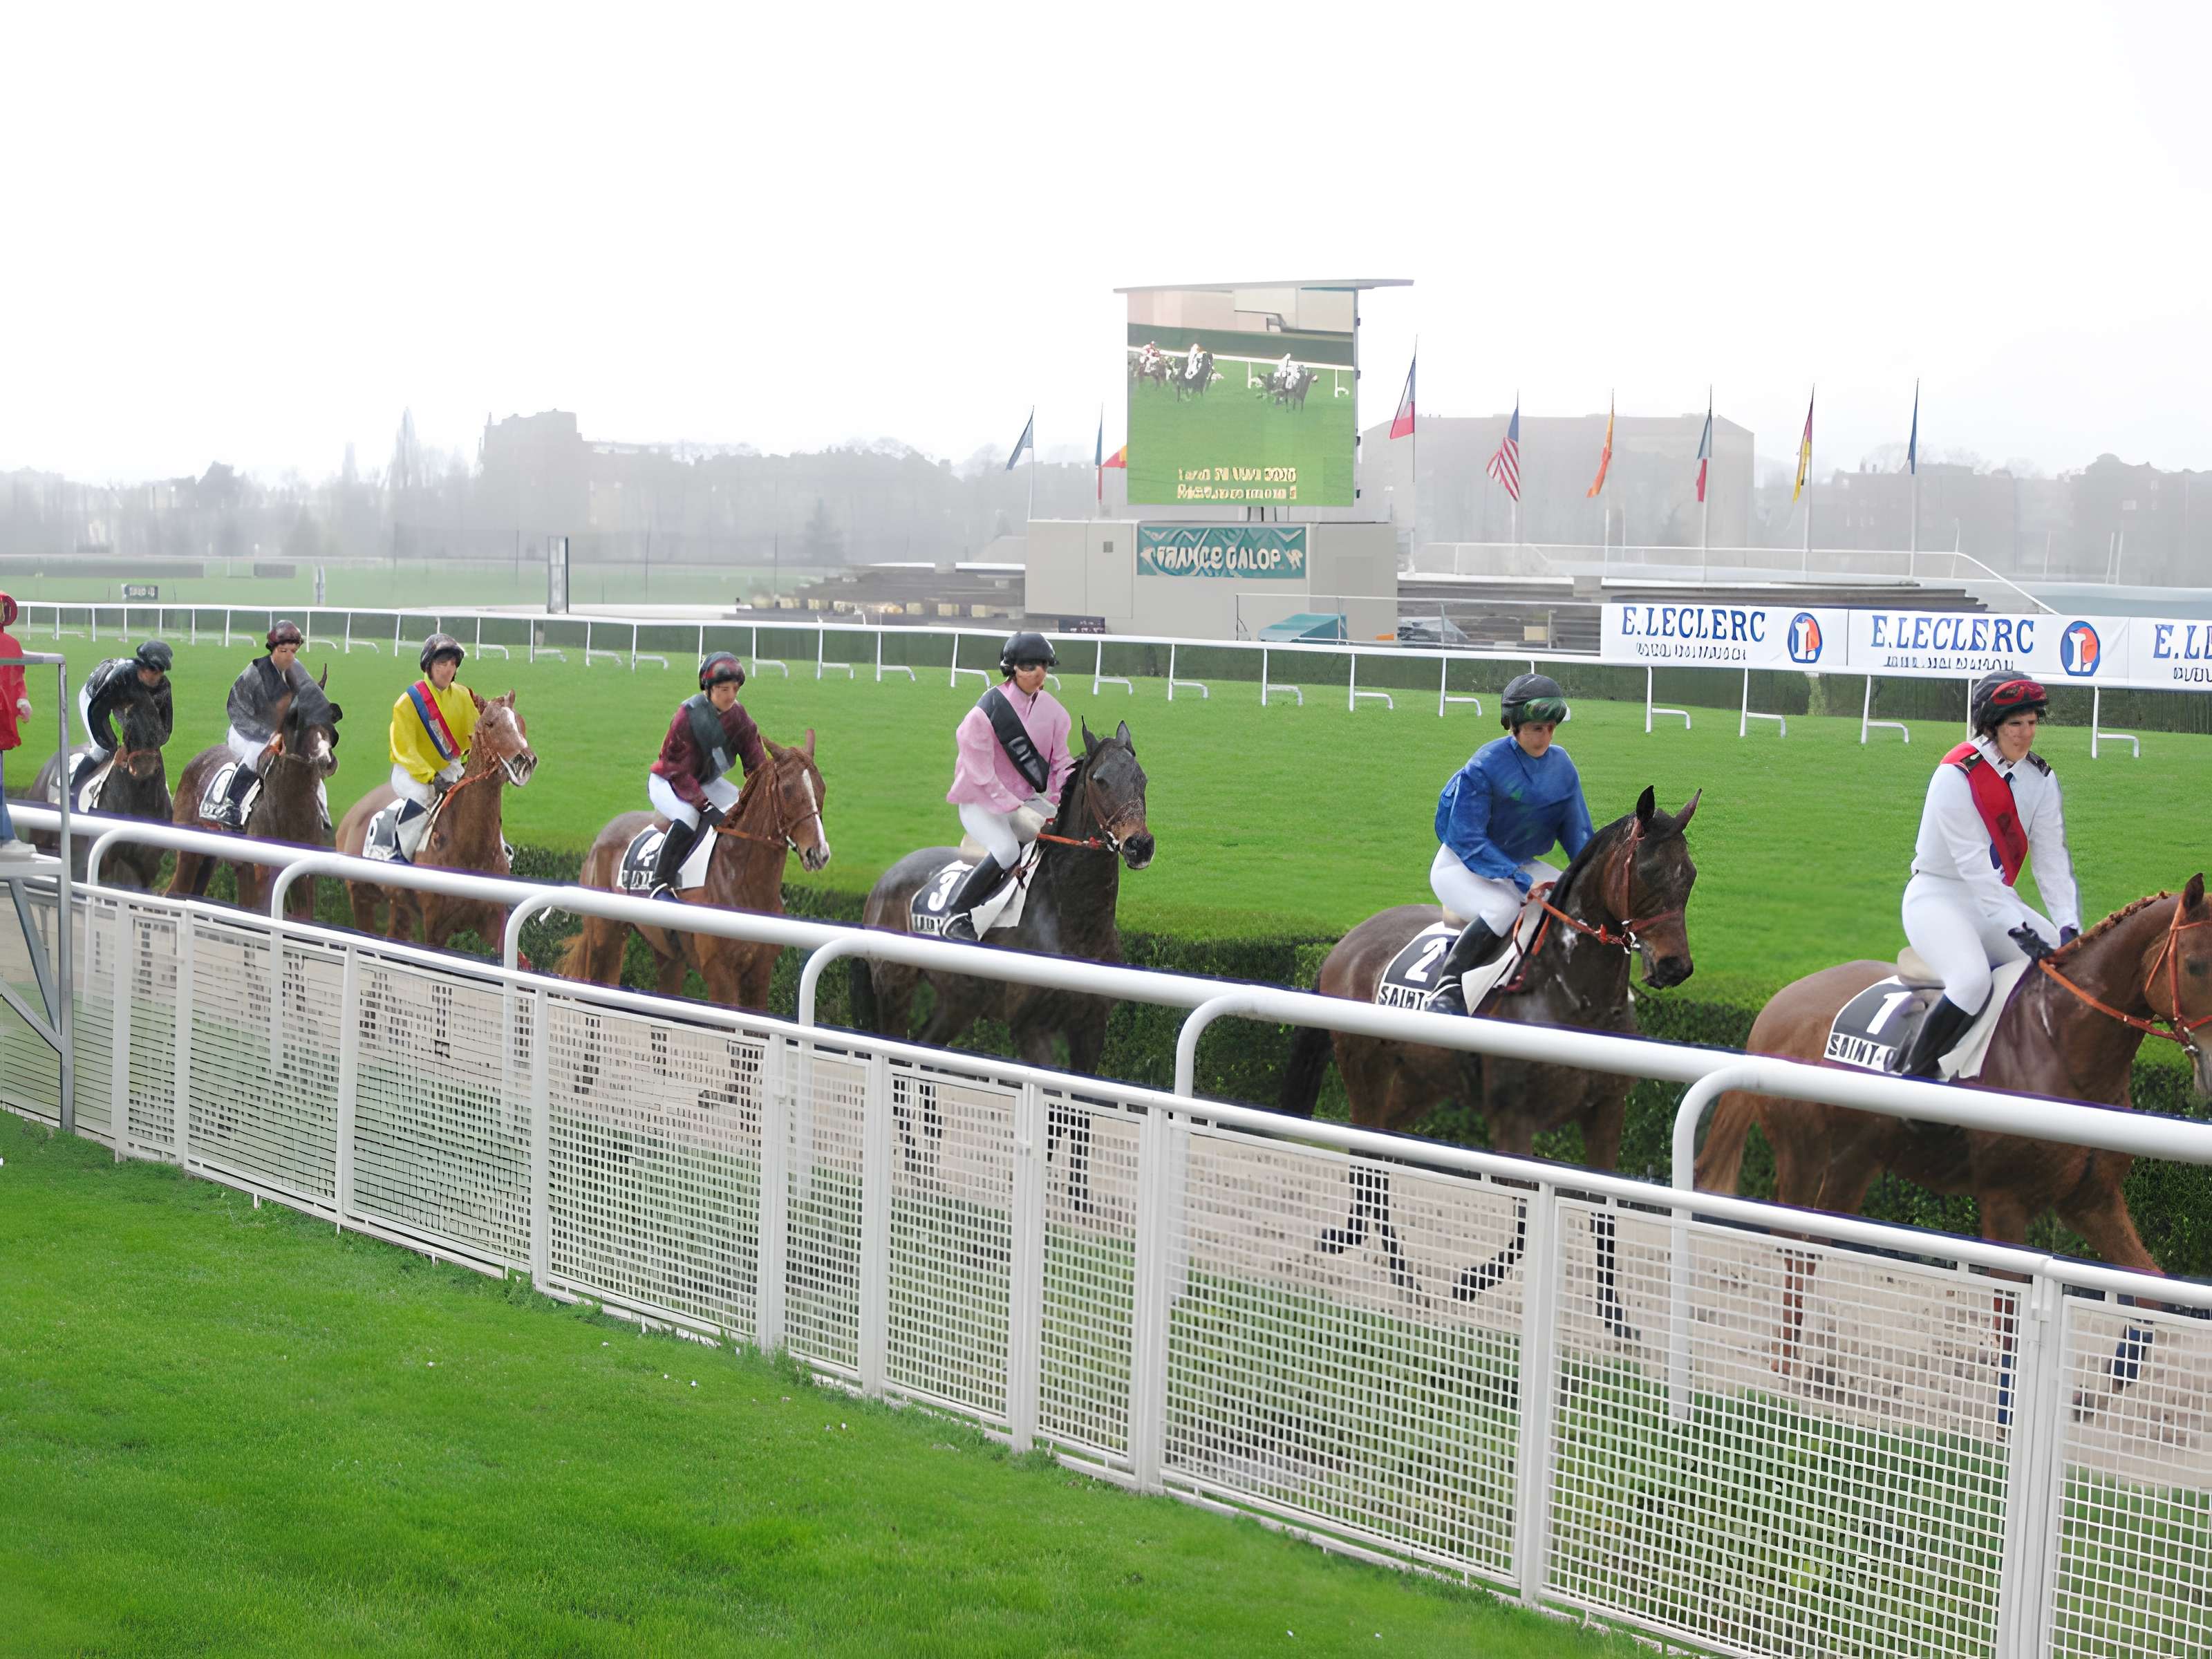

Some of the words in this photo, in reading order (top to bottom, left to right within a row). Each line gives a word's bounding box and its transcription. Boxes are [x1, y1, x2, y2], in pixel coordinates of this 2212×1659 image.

[1226, 545, 1281, 570] GALOP
[1621, 606, 1765, 642] E.LECLERC
[927, 868, 962, 912] 3
[1404, 937, 1448, 983] 2
[1866, 991, 1913, 1035] 1
